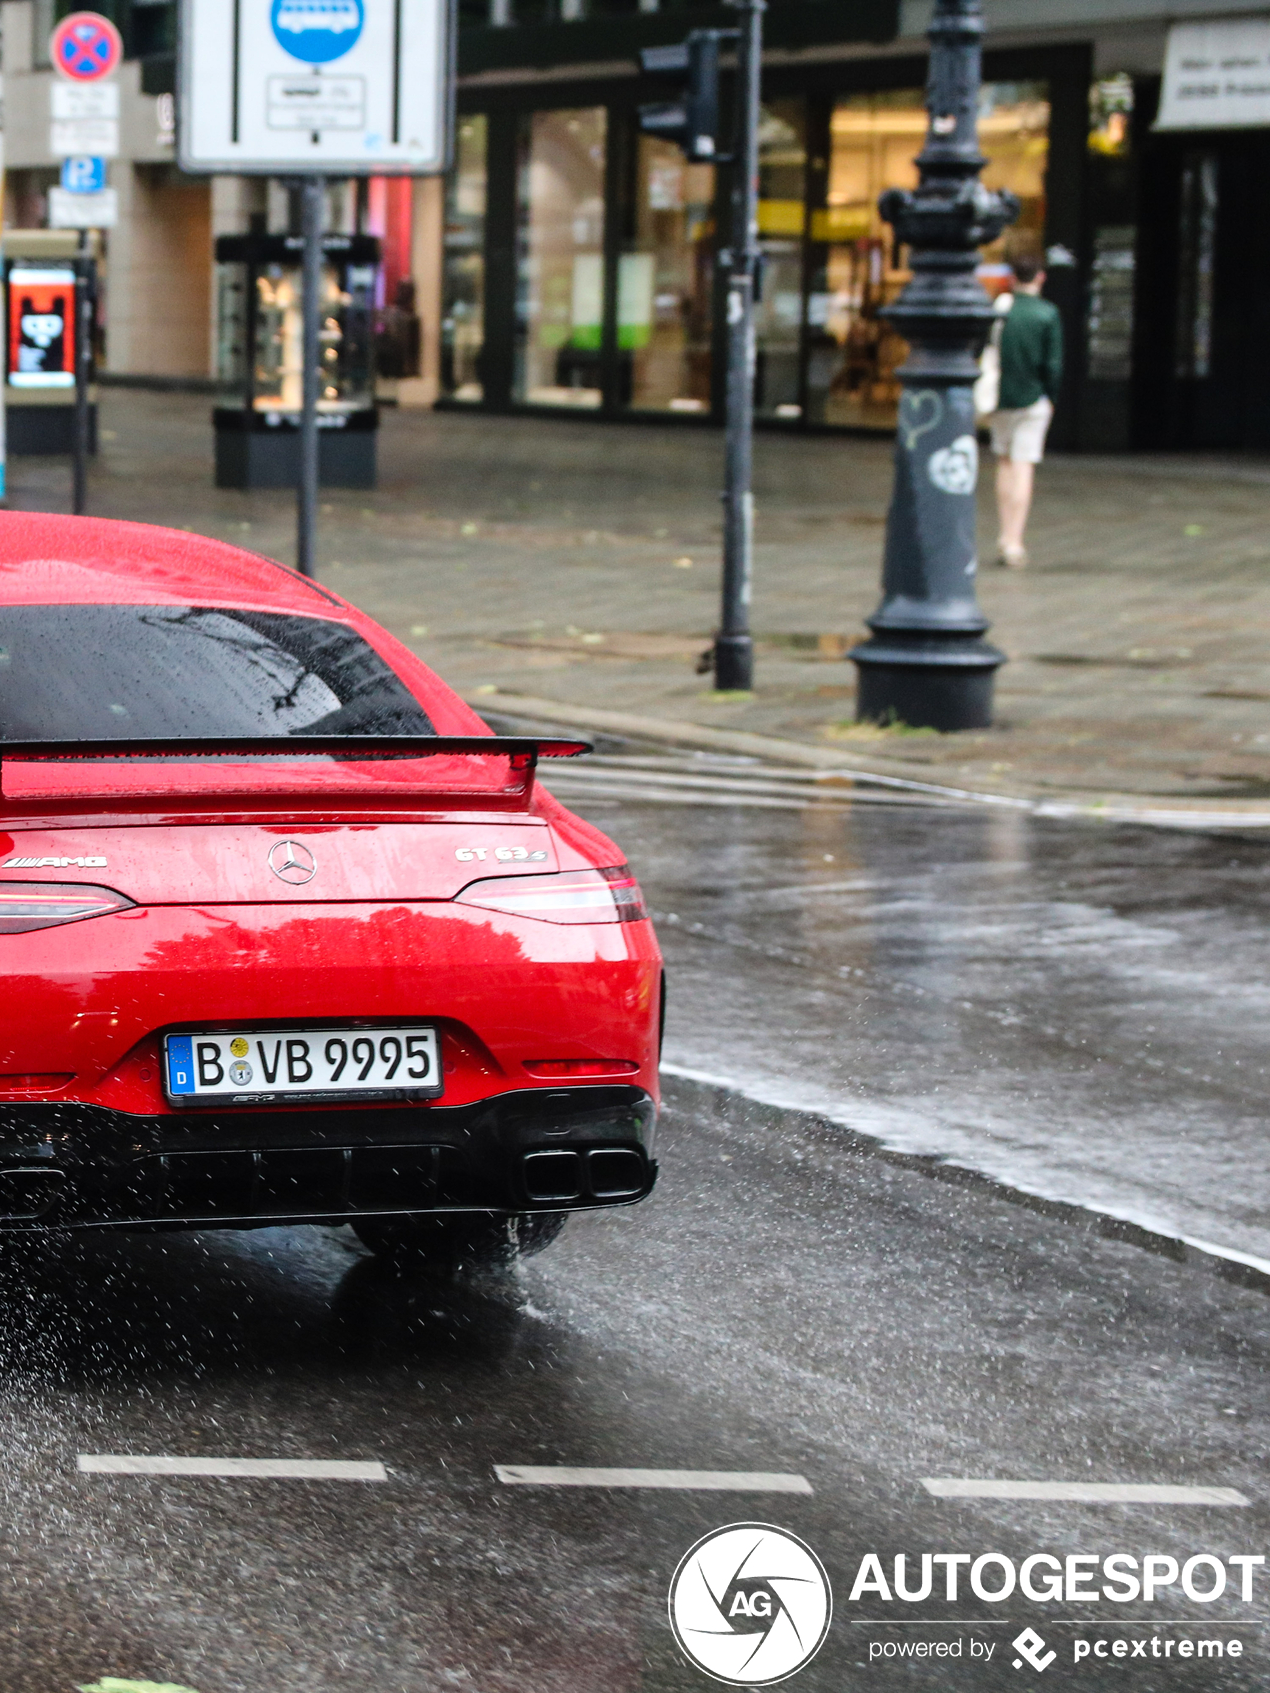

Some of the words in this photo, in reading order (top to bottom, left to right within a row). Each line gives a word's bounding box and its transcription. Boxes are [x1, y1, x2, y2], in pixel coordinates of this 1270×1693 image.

[455, 847, 488, 862] GT
[197, 1042, 224, 1086] B
[256, 1039, 313, 1084] VB
[325, 1035, 430, 1082] 9995
[177, 1071, 187, 1085] D
